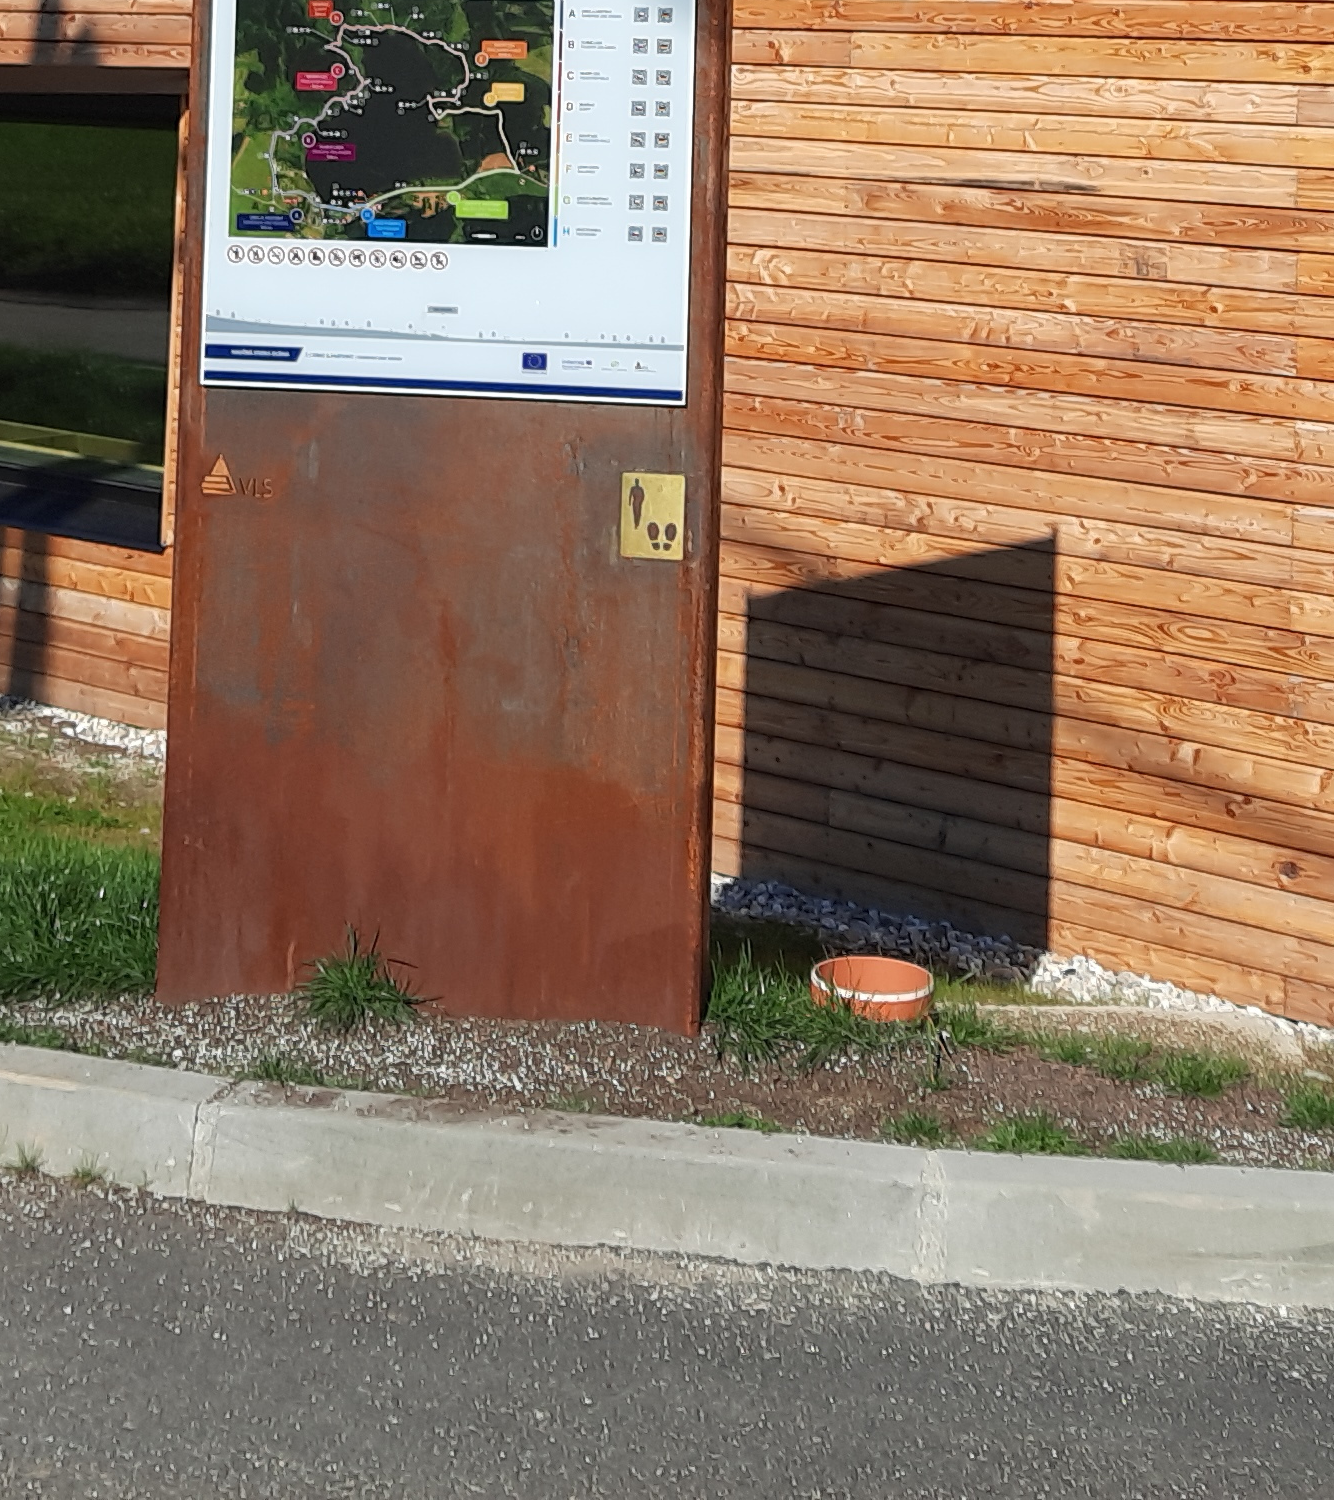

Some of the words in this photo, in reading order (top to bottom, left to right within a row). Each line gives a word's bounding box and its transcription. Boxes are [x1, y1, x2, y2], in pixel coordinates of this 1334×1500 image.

[568, 8, 576, 19] A
[567, 40, 575, 49] B
[566, 71, 575, 81] C
[239, 477, 274, 499] VLS
